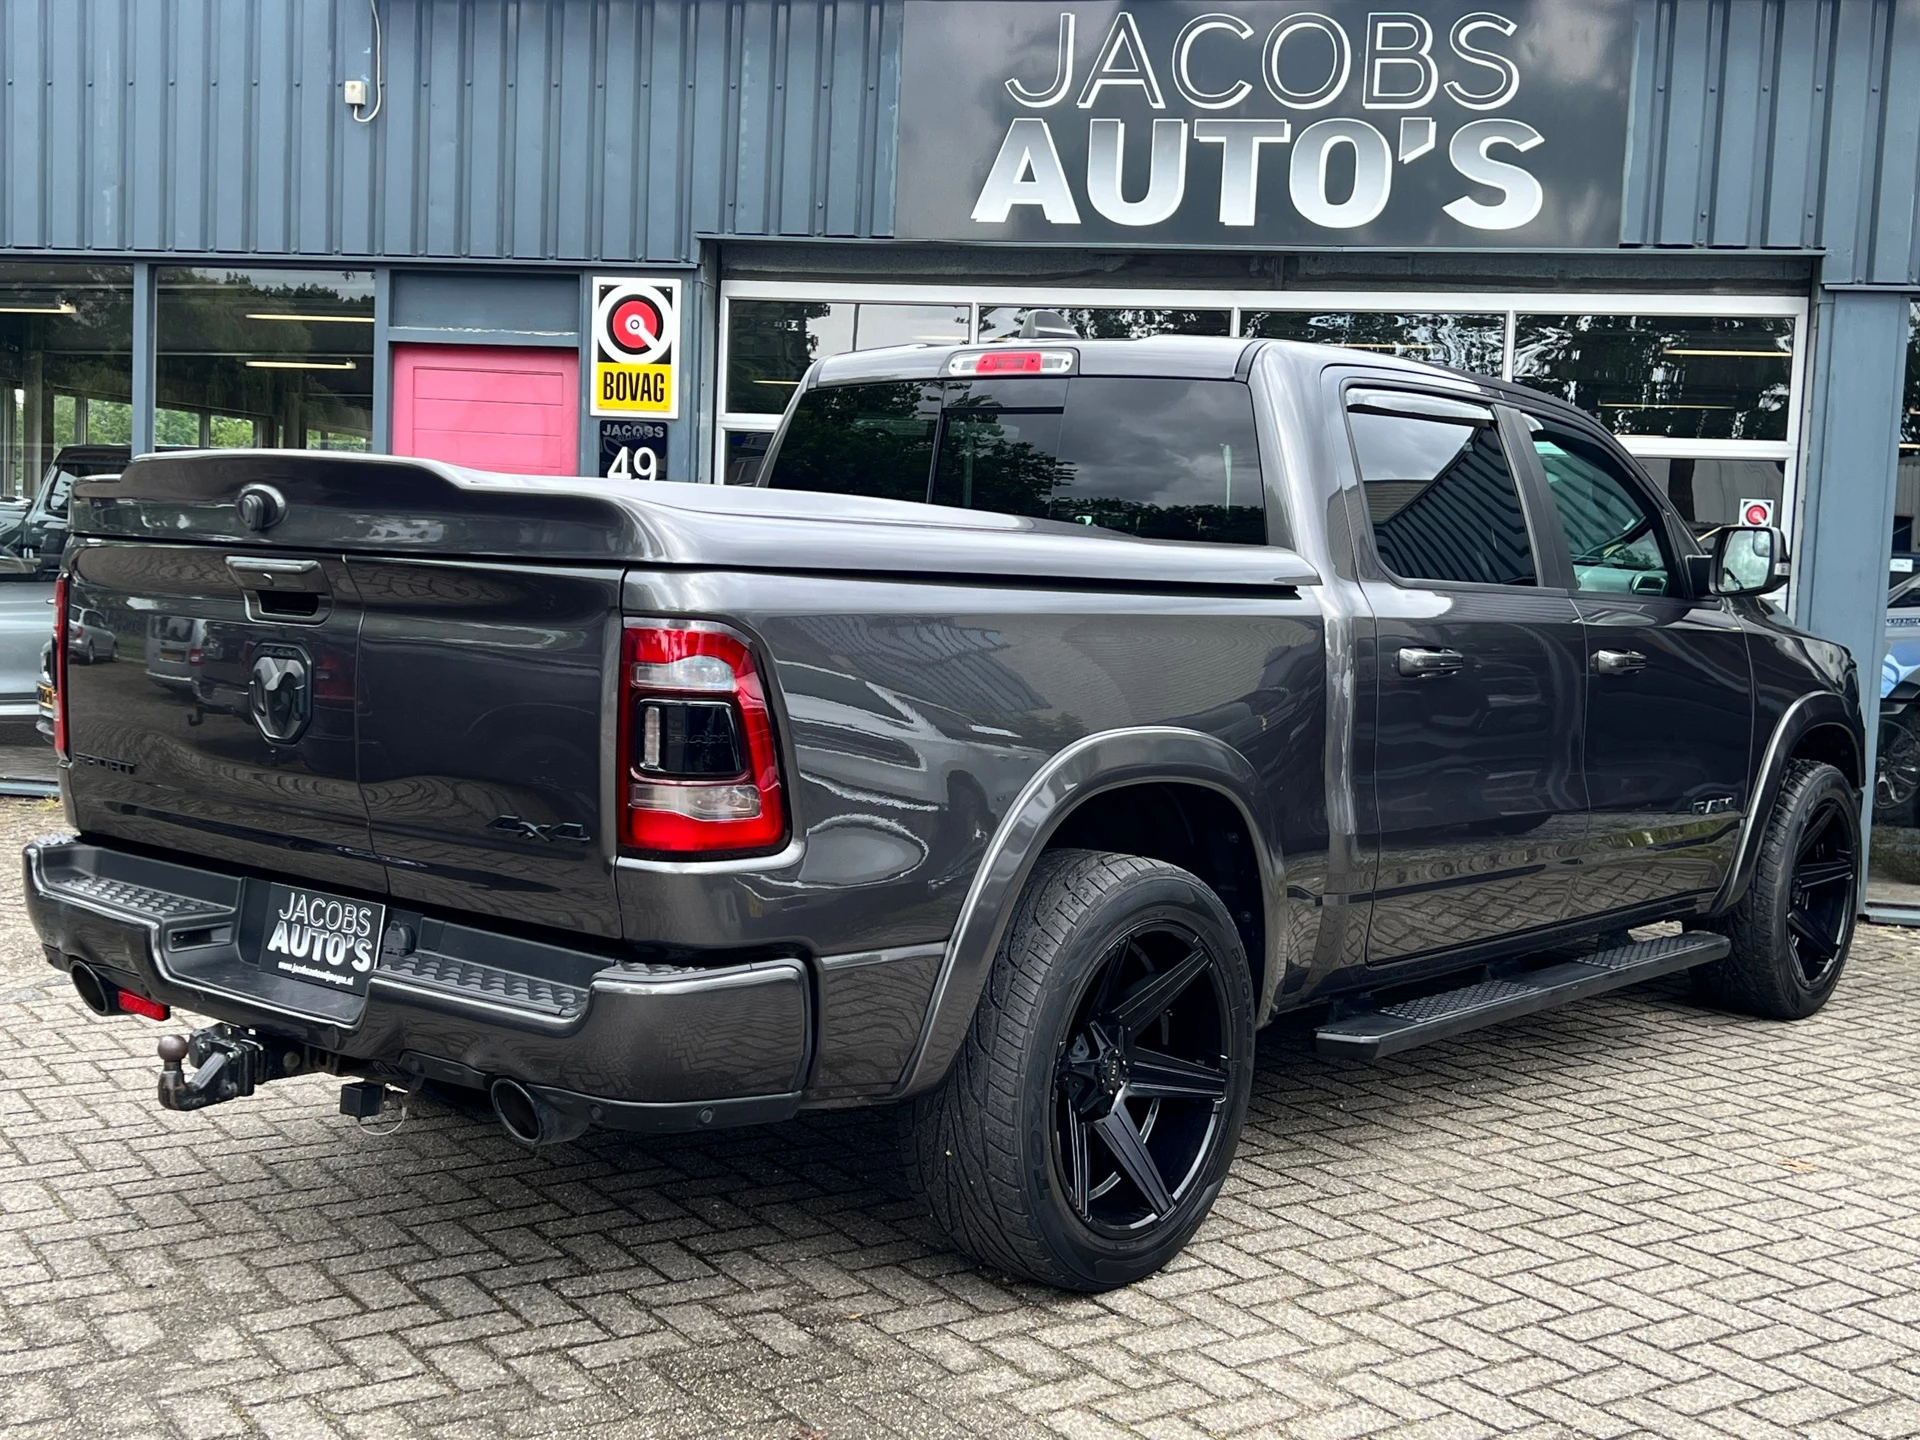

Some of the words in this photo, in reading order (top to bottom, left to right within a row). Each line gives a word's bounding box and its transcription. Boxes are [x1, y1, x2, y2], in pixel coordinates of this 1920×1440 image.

[1004, 11, 1520, 111] JACOBS
[970, 117, 1545, 230] AUTO'S
[603, 371, 664, 402] BOVAG
[602, 424, 664, 438] JACOBS
[278, 891, 372, 937] JACOBS
[267, 919, 373, 973] AUTO'S
